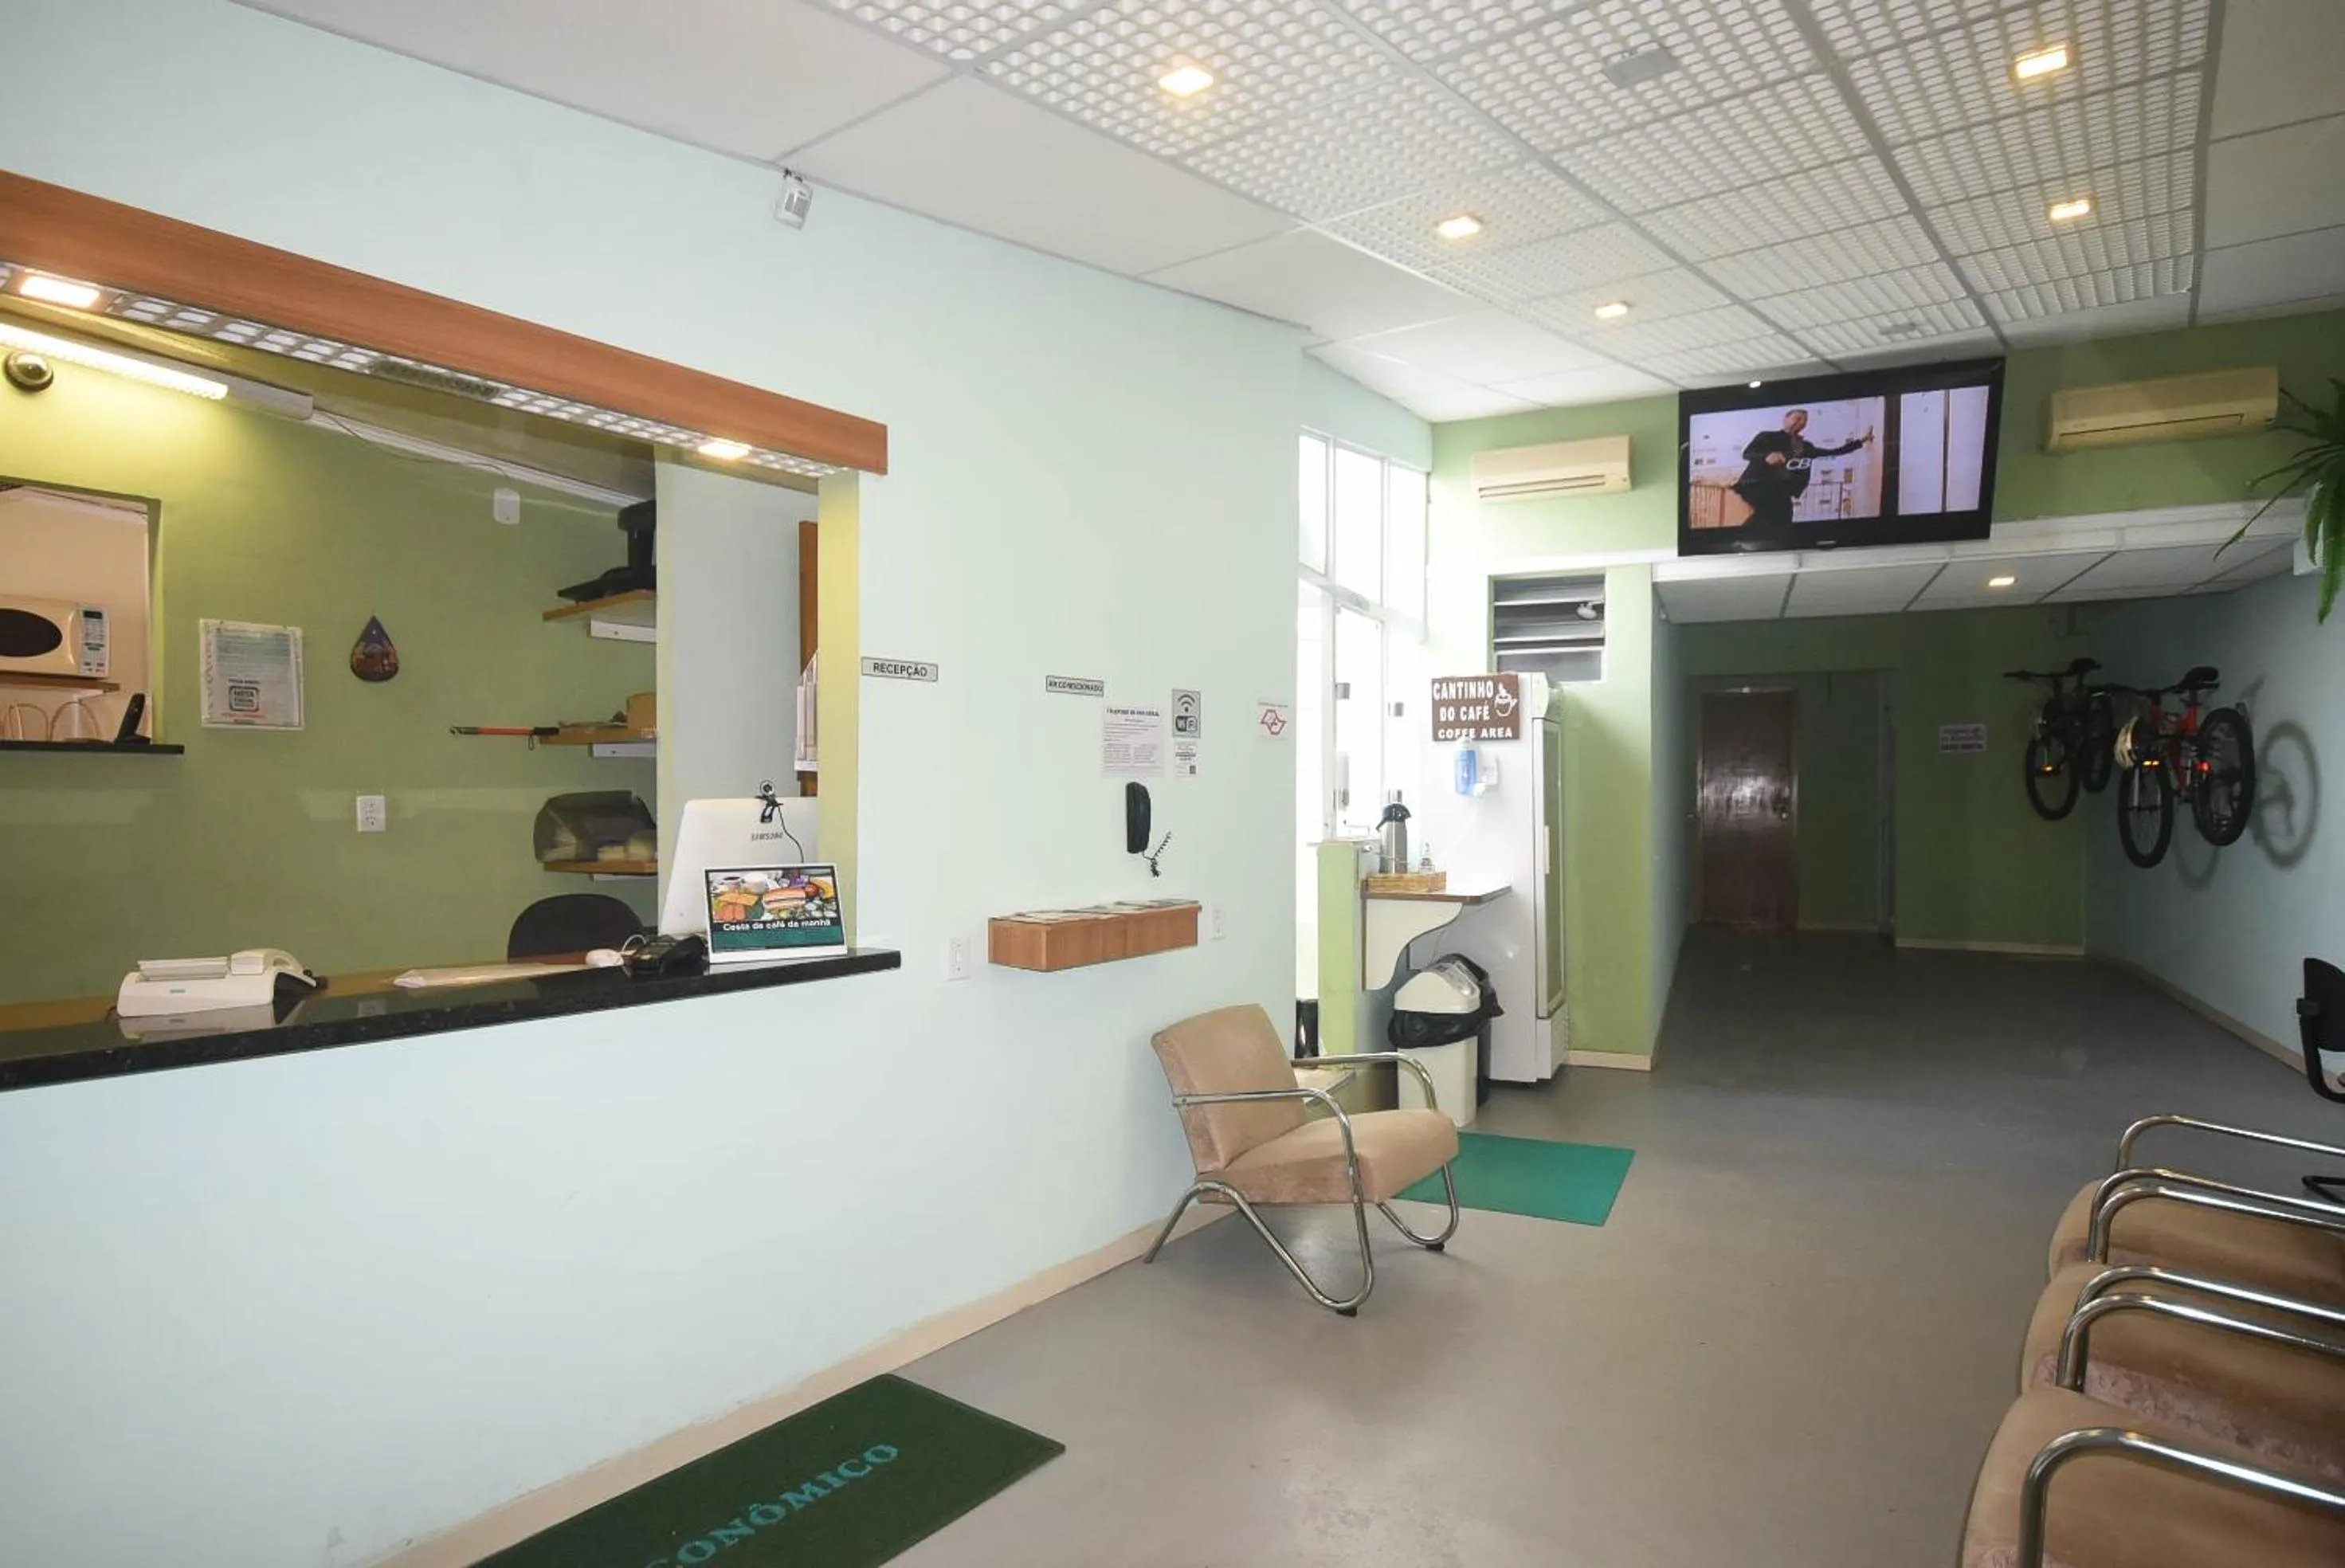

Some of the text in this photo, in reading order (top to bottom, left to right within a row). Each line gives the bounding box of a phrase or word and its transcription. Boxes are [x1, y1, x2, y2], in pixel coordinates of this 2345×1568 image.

[873, 662, 928, 678] RECEPÇÃO
[1433, 681, 1494, 700] CANTINHO
[1439, 700, 1491, 721] DO CAFÉ
[1480, 727, 1512, 739] AREA
[723, 923, 750, 931] Cesta
